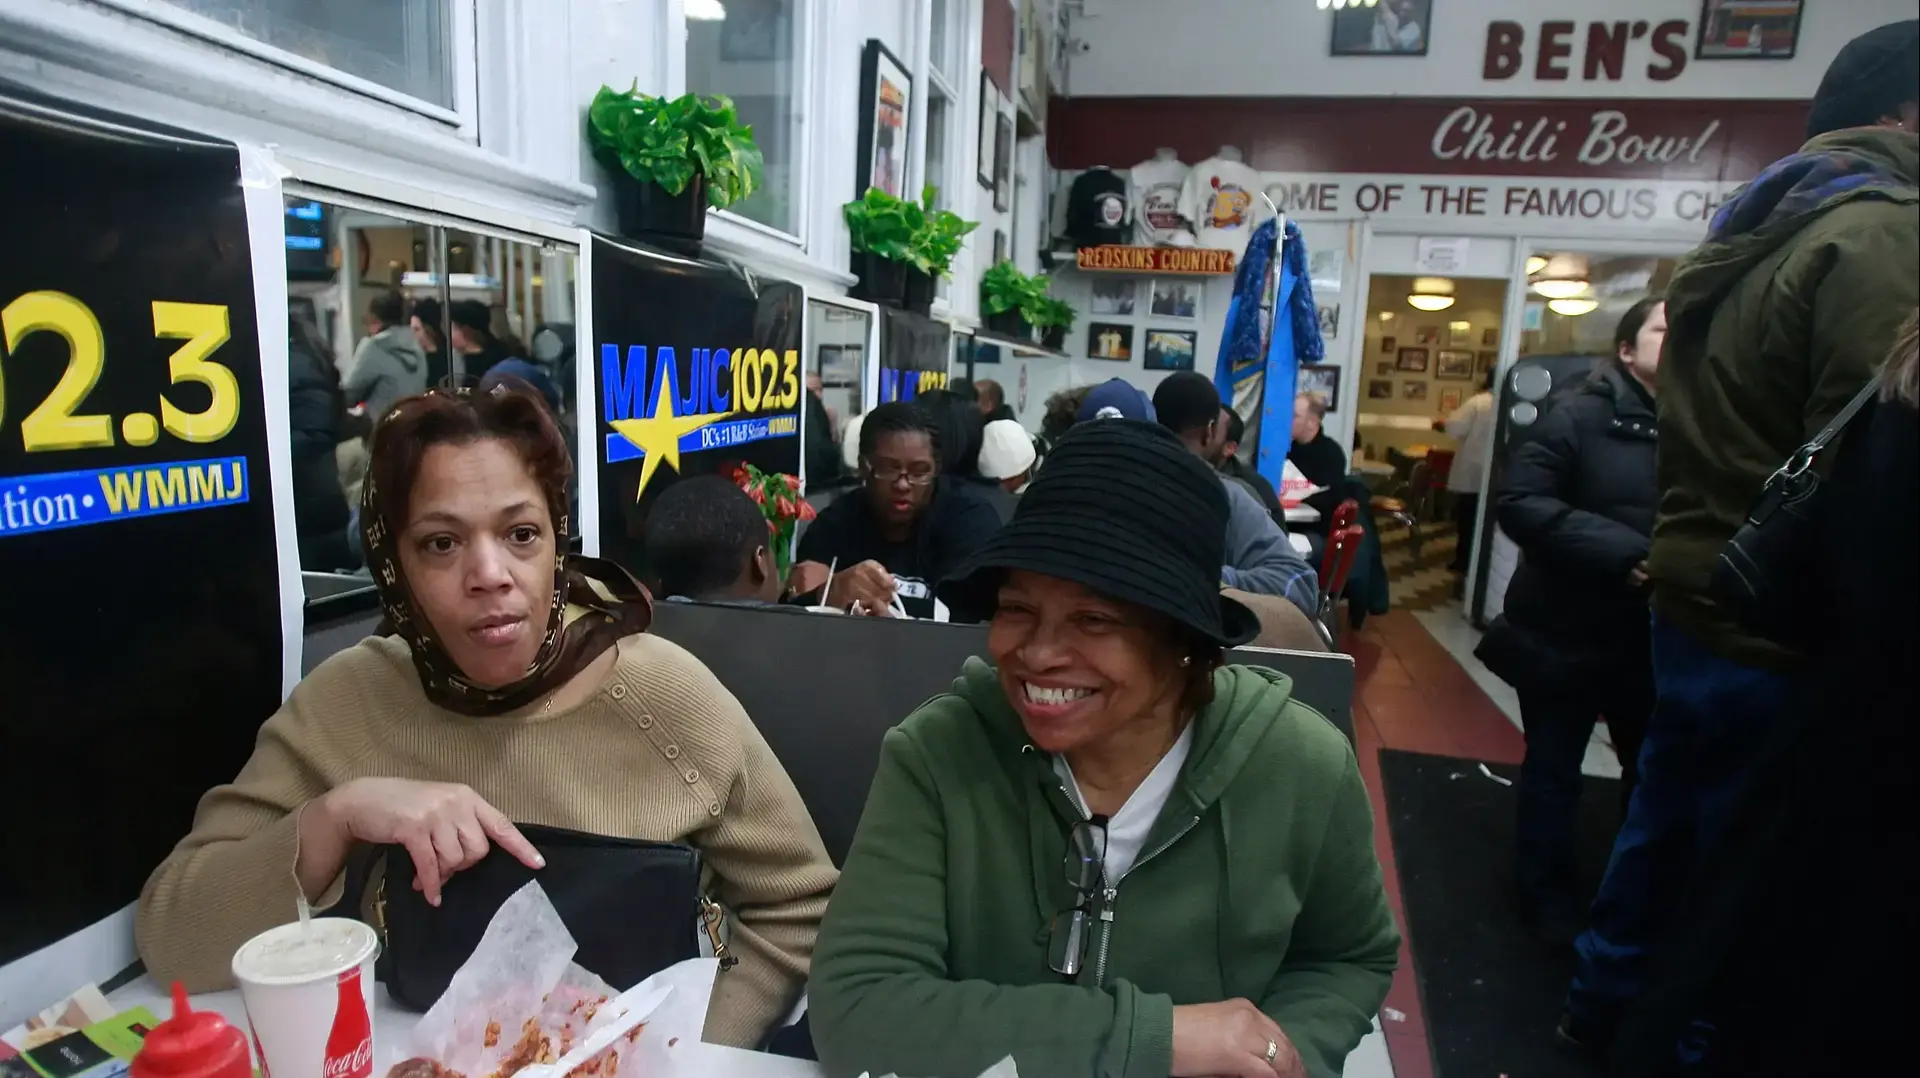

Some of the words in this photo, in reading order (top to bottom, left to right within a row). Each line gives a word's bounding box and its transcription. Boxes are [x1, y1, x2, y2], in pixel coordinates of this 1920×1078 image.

[1482, 19, 1690, 82] BEN'S
[1431, 106, 1568, 163] Chili
[1577, 110, 1721, 165] Bowl
[1264, 182, 1340, 213] OME
[1355, 182, 1404, 212] OF
[1420, 184, 1489, 215] THE
[1503, 187, 1658, 220] FAMOUS
[1675, 189, 1725, 220] CH
[1085, 246, 1154, 270] REDSKINS
[1161, 249, 1228, 273] COUNTRY
[0, 290, 241, 453] 2.3
[701, 427, 721, 448] DC's
[0, 484, 80, 530] tion
[98, 461, 243, 515] WMMJ
